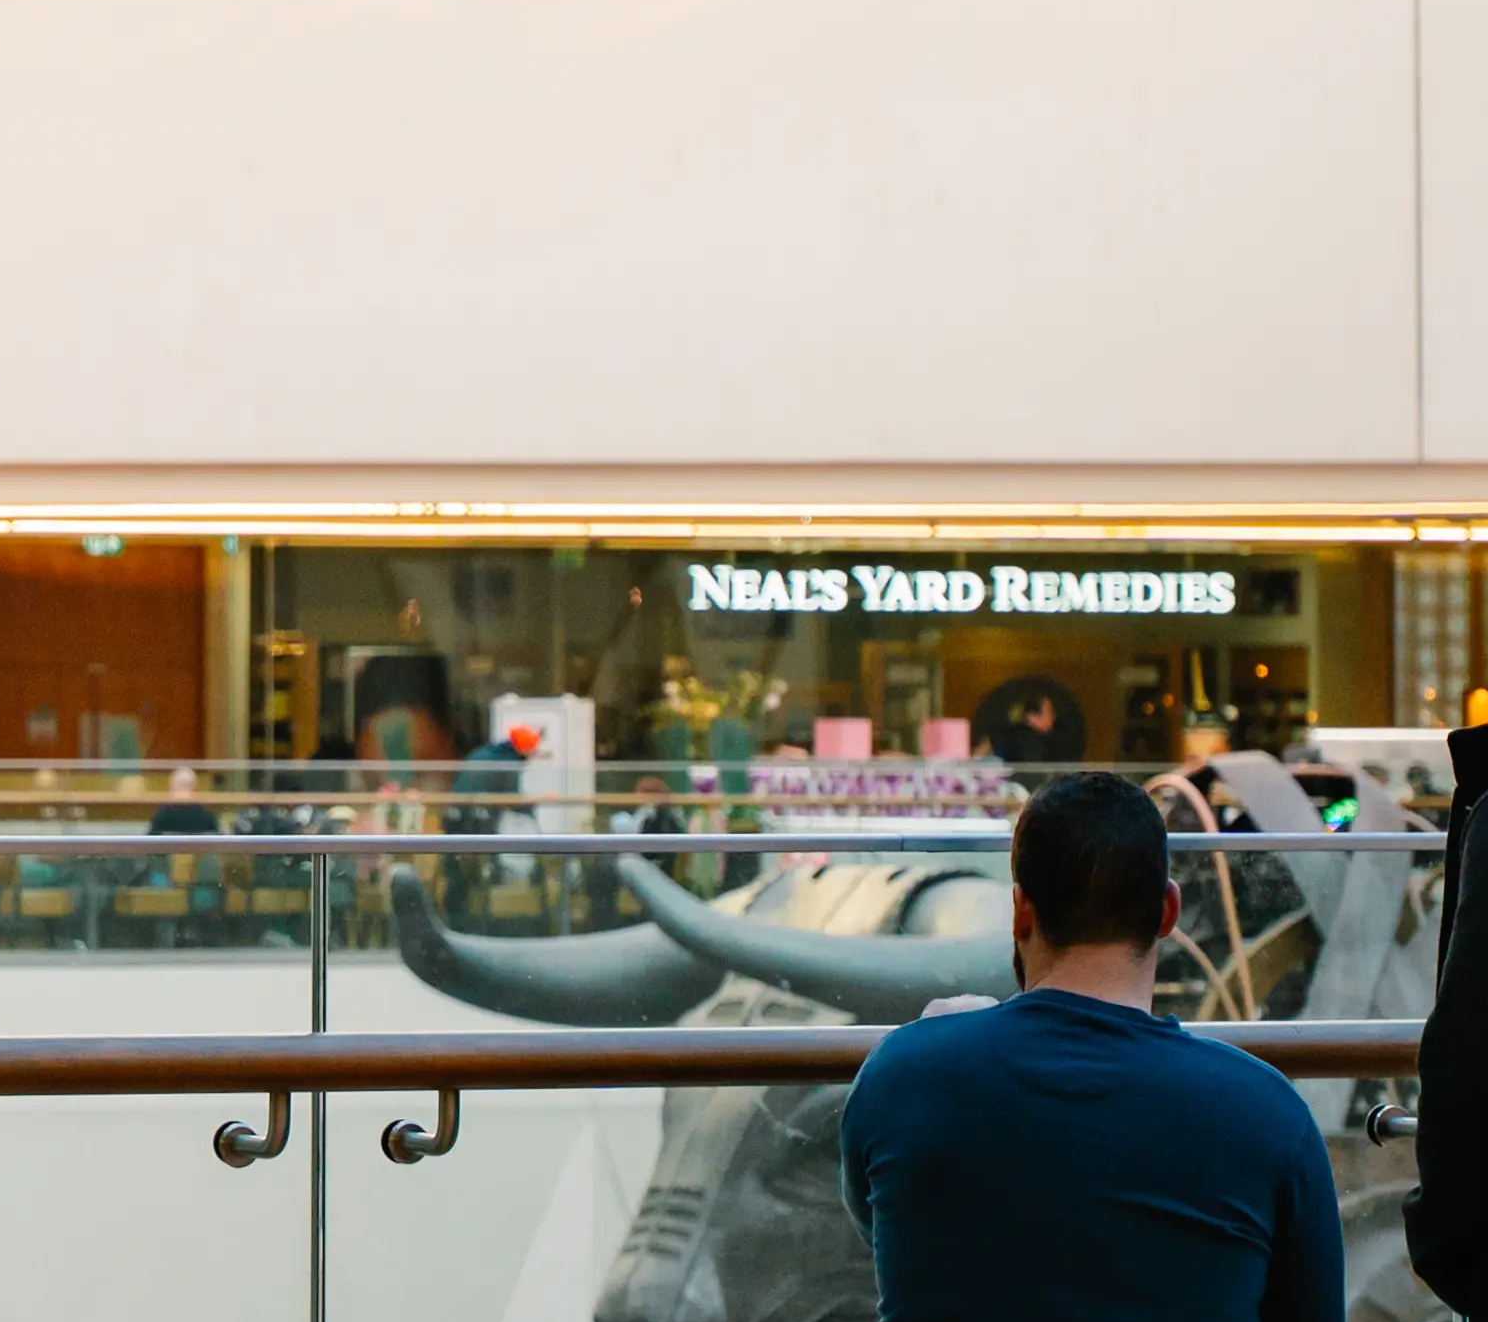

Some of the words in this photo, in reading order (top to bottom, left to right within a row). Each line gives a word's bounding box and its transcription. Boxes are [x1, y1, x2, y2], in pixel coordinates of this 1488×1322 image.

[688, 563, 849, 613] NEAL'S
[852, 564, 986, 614] YARD
[989, 565, 1237, 615] REMEDIES
